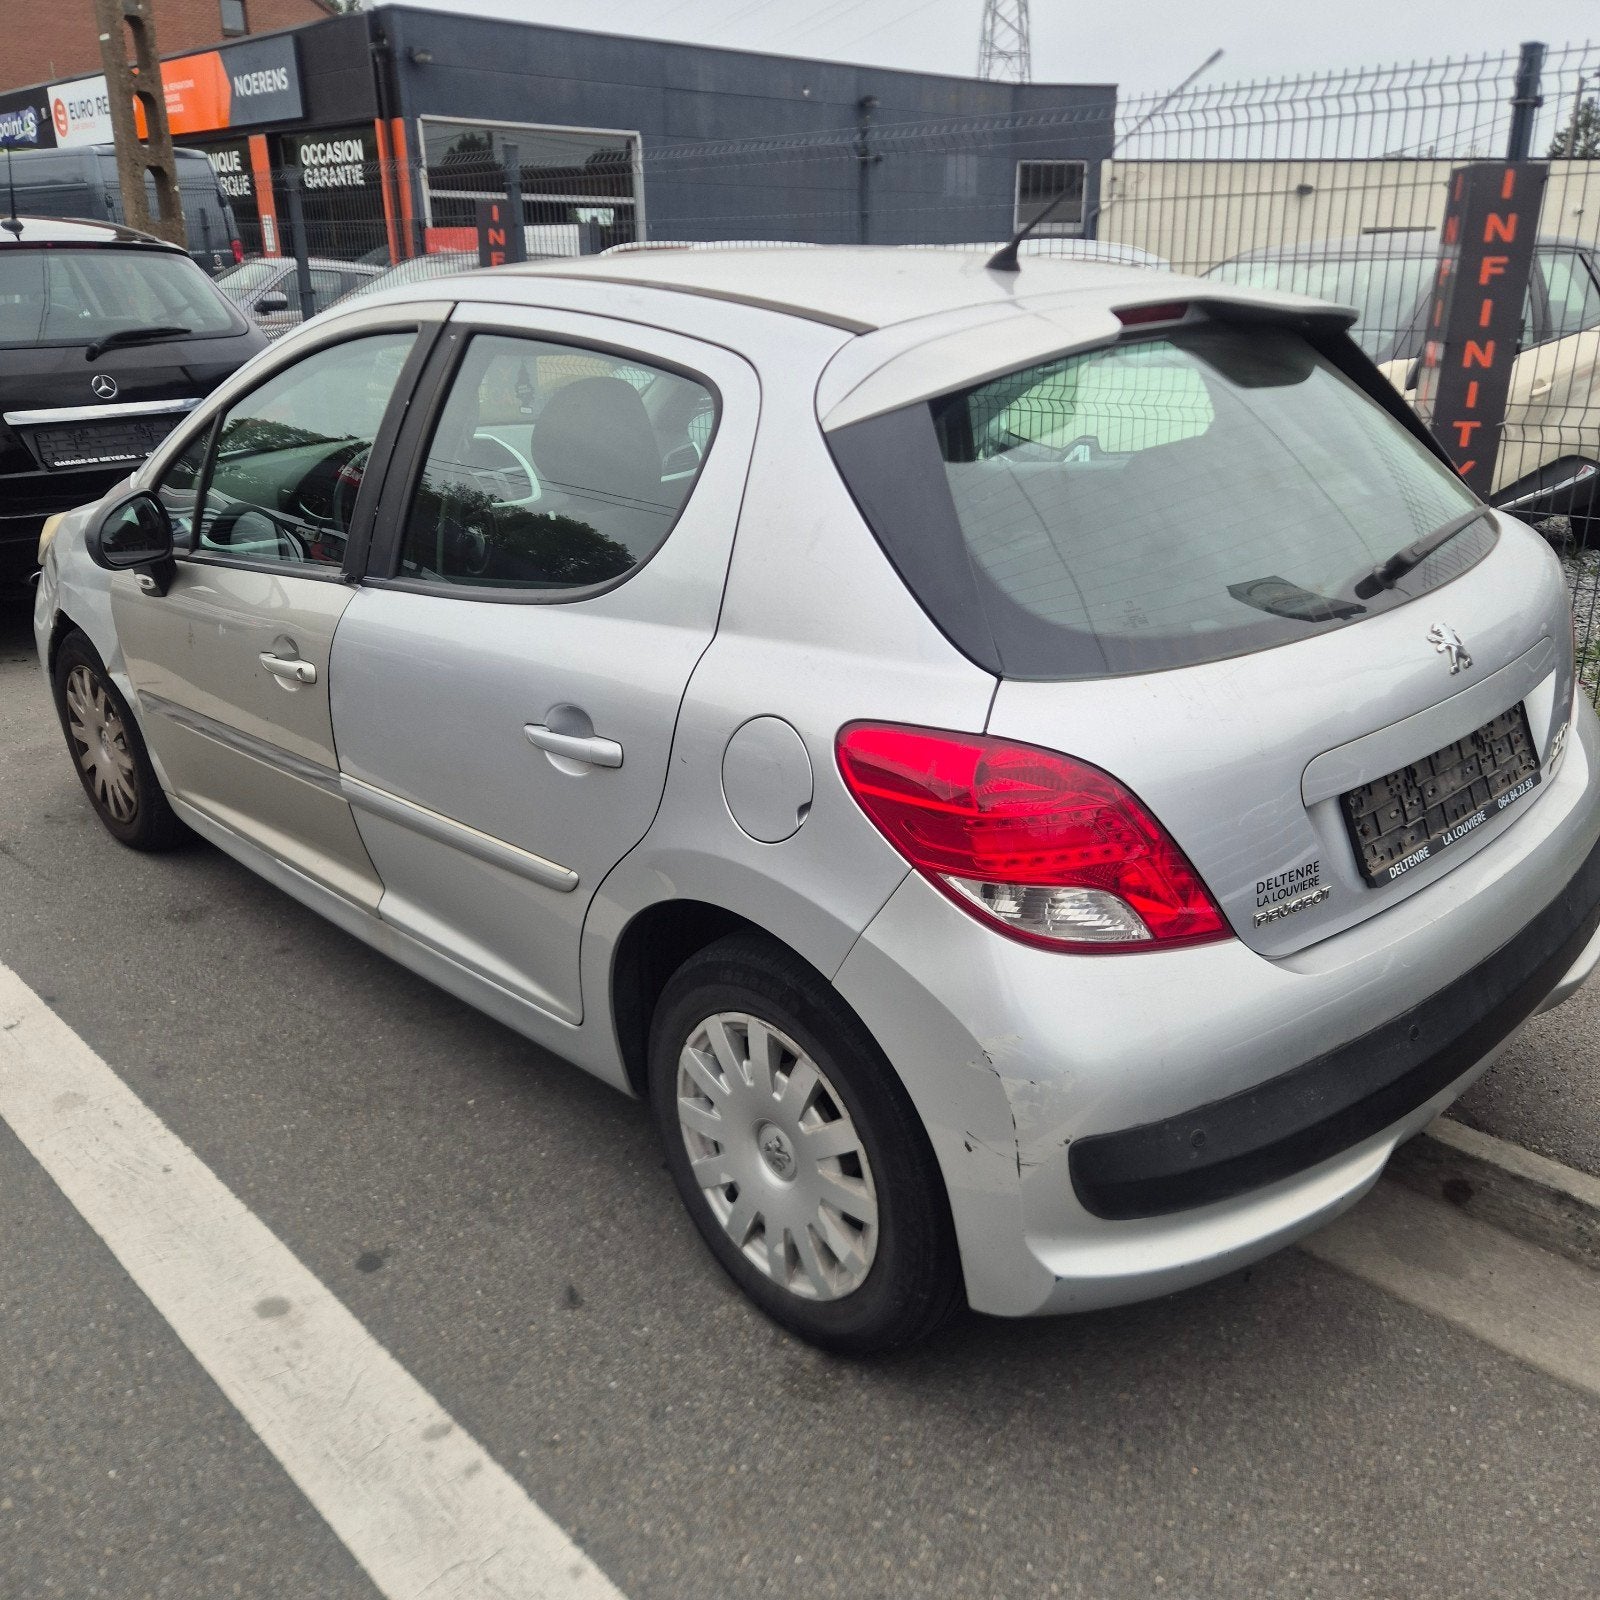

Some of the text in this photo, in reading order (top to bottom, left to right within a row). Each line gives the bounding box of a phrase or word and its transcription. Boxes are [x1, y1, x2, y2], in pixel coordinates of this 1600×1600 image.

[234, 67, 288, 97] NOERENS
[69, 99, 93, 120] EURO
[301, 139, 364, 166] OCCASION
[303, 164, 365, 189] GARANTIE
[1388, 846, 1431, 879] DELTENRE
[1442, 833, 1454, 846] LA
[1453, 810, 1487, 839] LOUVIERE
[1256, 860, 1319, 894] DELTENRE
[1257, 875, 1319, 908] LA LOUVIERE
[1253, 886, 1332, 928] PEUGEOT
